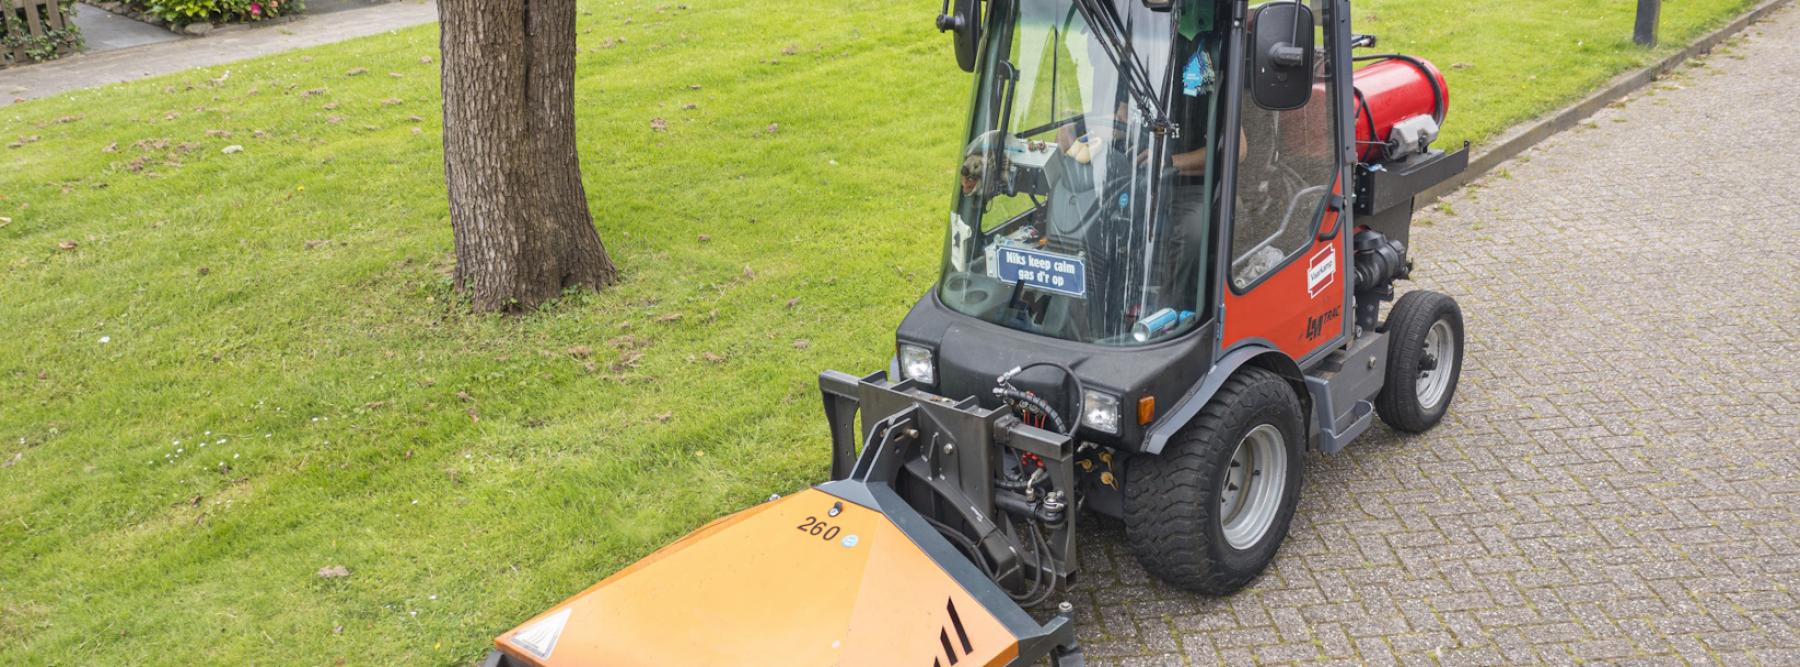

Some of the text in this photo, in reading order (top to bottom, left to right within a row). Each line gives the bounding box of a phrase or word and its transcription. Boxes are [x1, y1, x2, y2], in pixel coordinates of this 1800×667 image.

[1006, 251, 1075, 274] Niks keep calm
[1018, 269, 1064, 286] gas d'r op
[797, 516, 841, 541] 260
